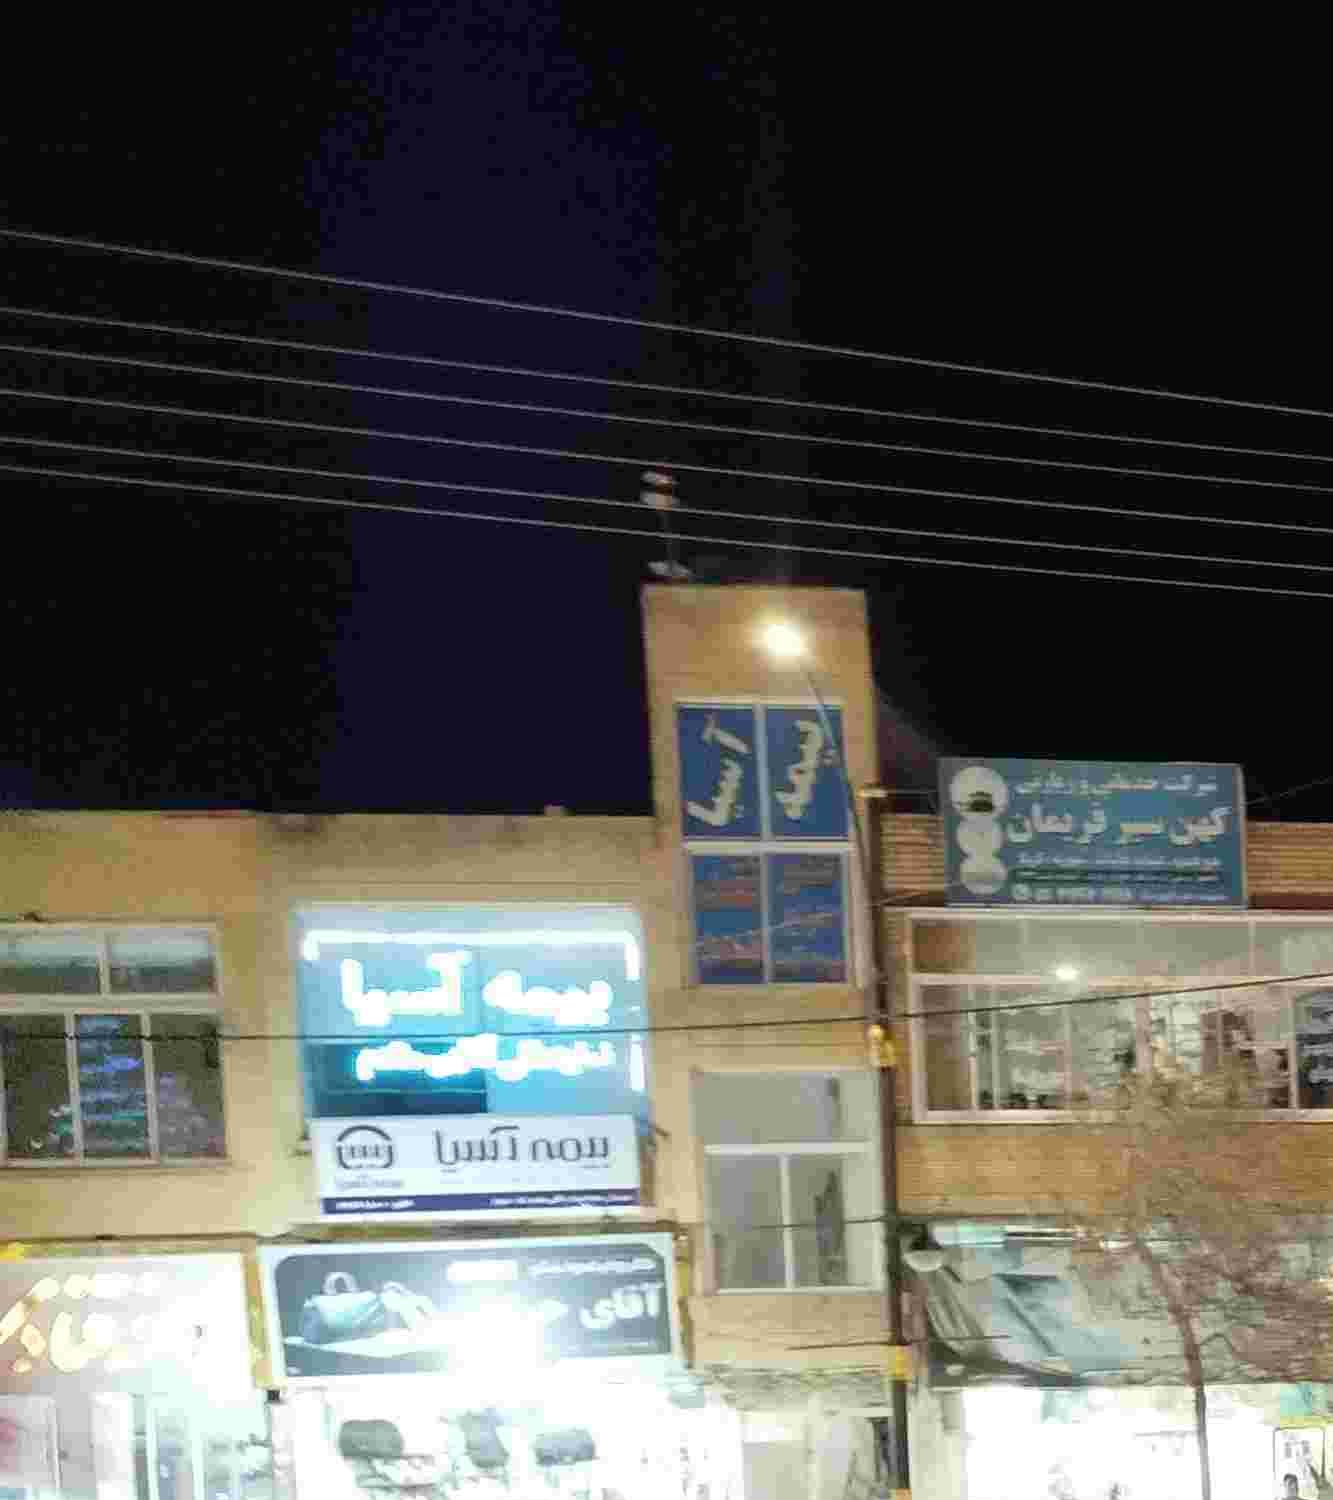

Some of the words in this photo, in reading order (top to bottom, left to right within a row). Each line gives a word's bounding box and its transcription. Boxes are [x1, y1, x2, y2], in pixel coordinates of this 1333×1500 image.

[688, 713, 752, 826] آسیا
[433, 1125, 521, 1174] آسیا
[530, 1135, 610, 1169] بیمه
[578, 1281, 664, 1329] آقای
